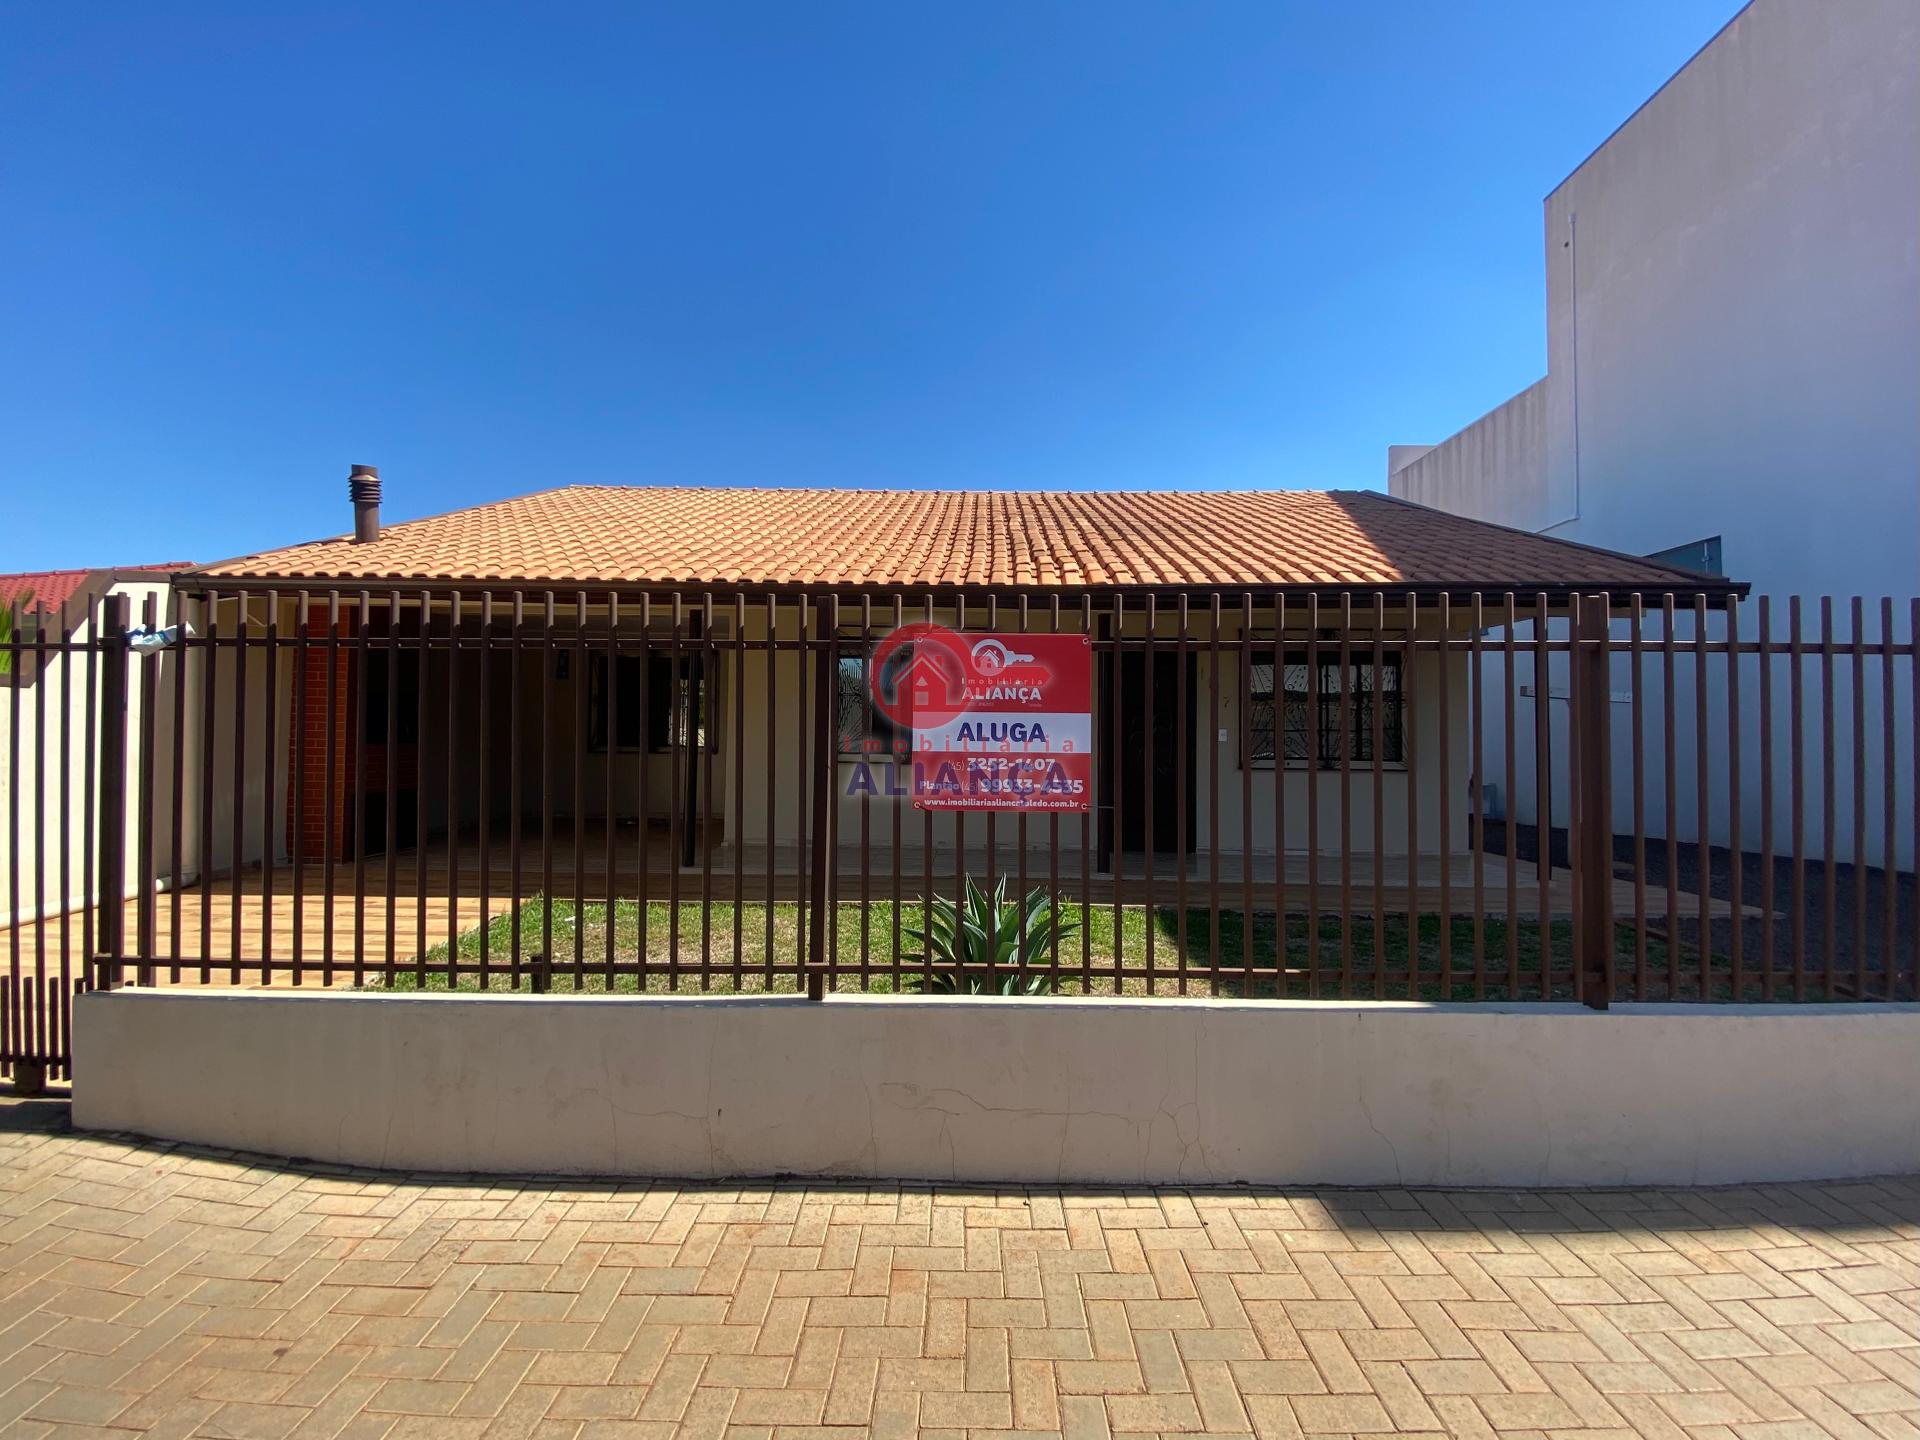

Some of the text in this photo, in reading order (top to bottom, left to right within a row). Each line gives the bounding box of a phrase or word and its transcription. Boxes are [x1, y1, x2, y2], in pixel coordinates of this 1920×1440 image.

[961, 687, 1042, 704] ALIANÇA
[957, 722, 1046, 743] ALUGA
[966, 757, 1056, 773] 3252-1407
[980, 778, 1084, 794] 99933-4535
